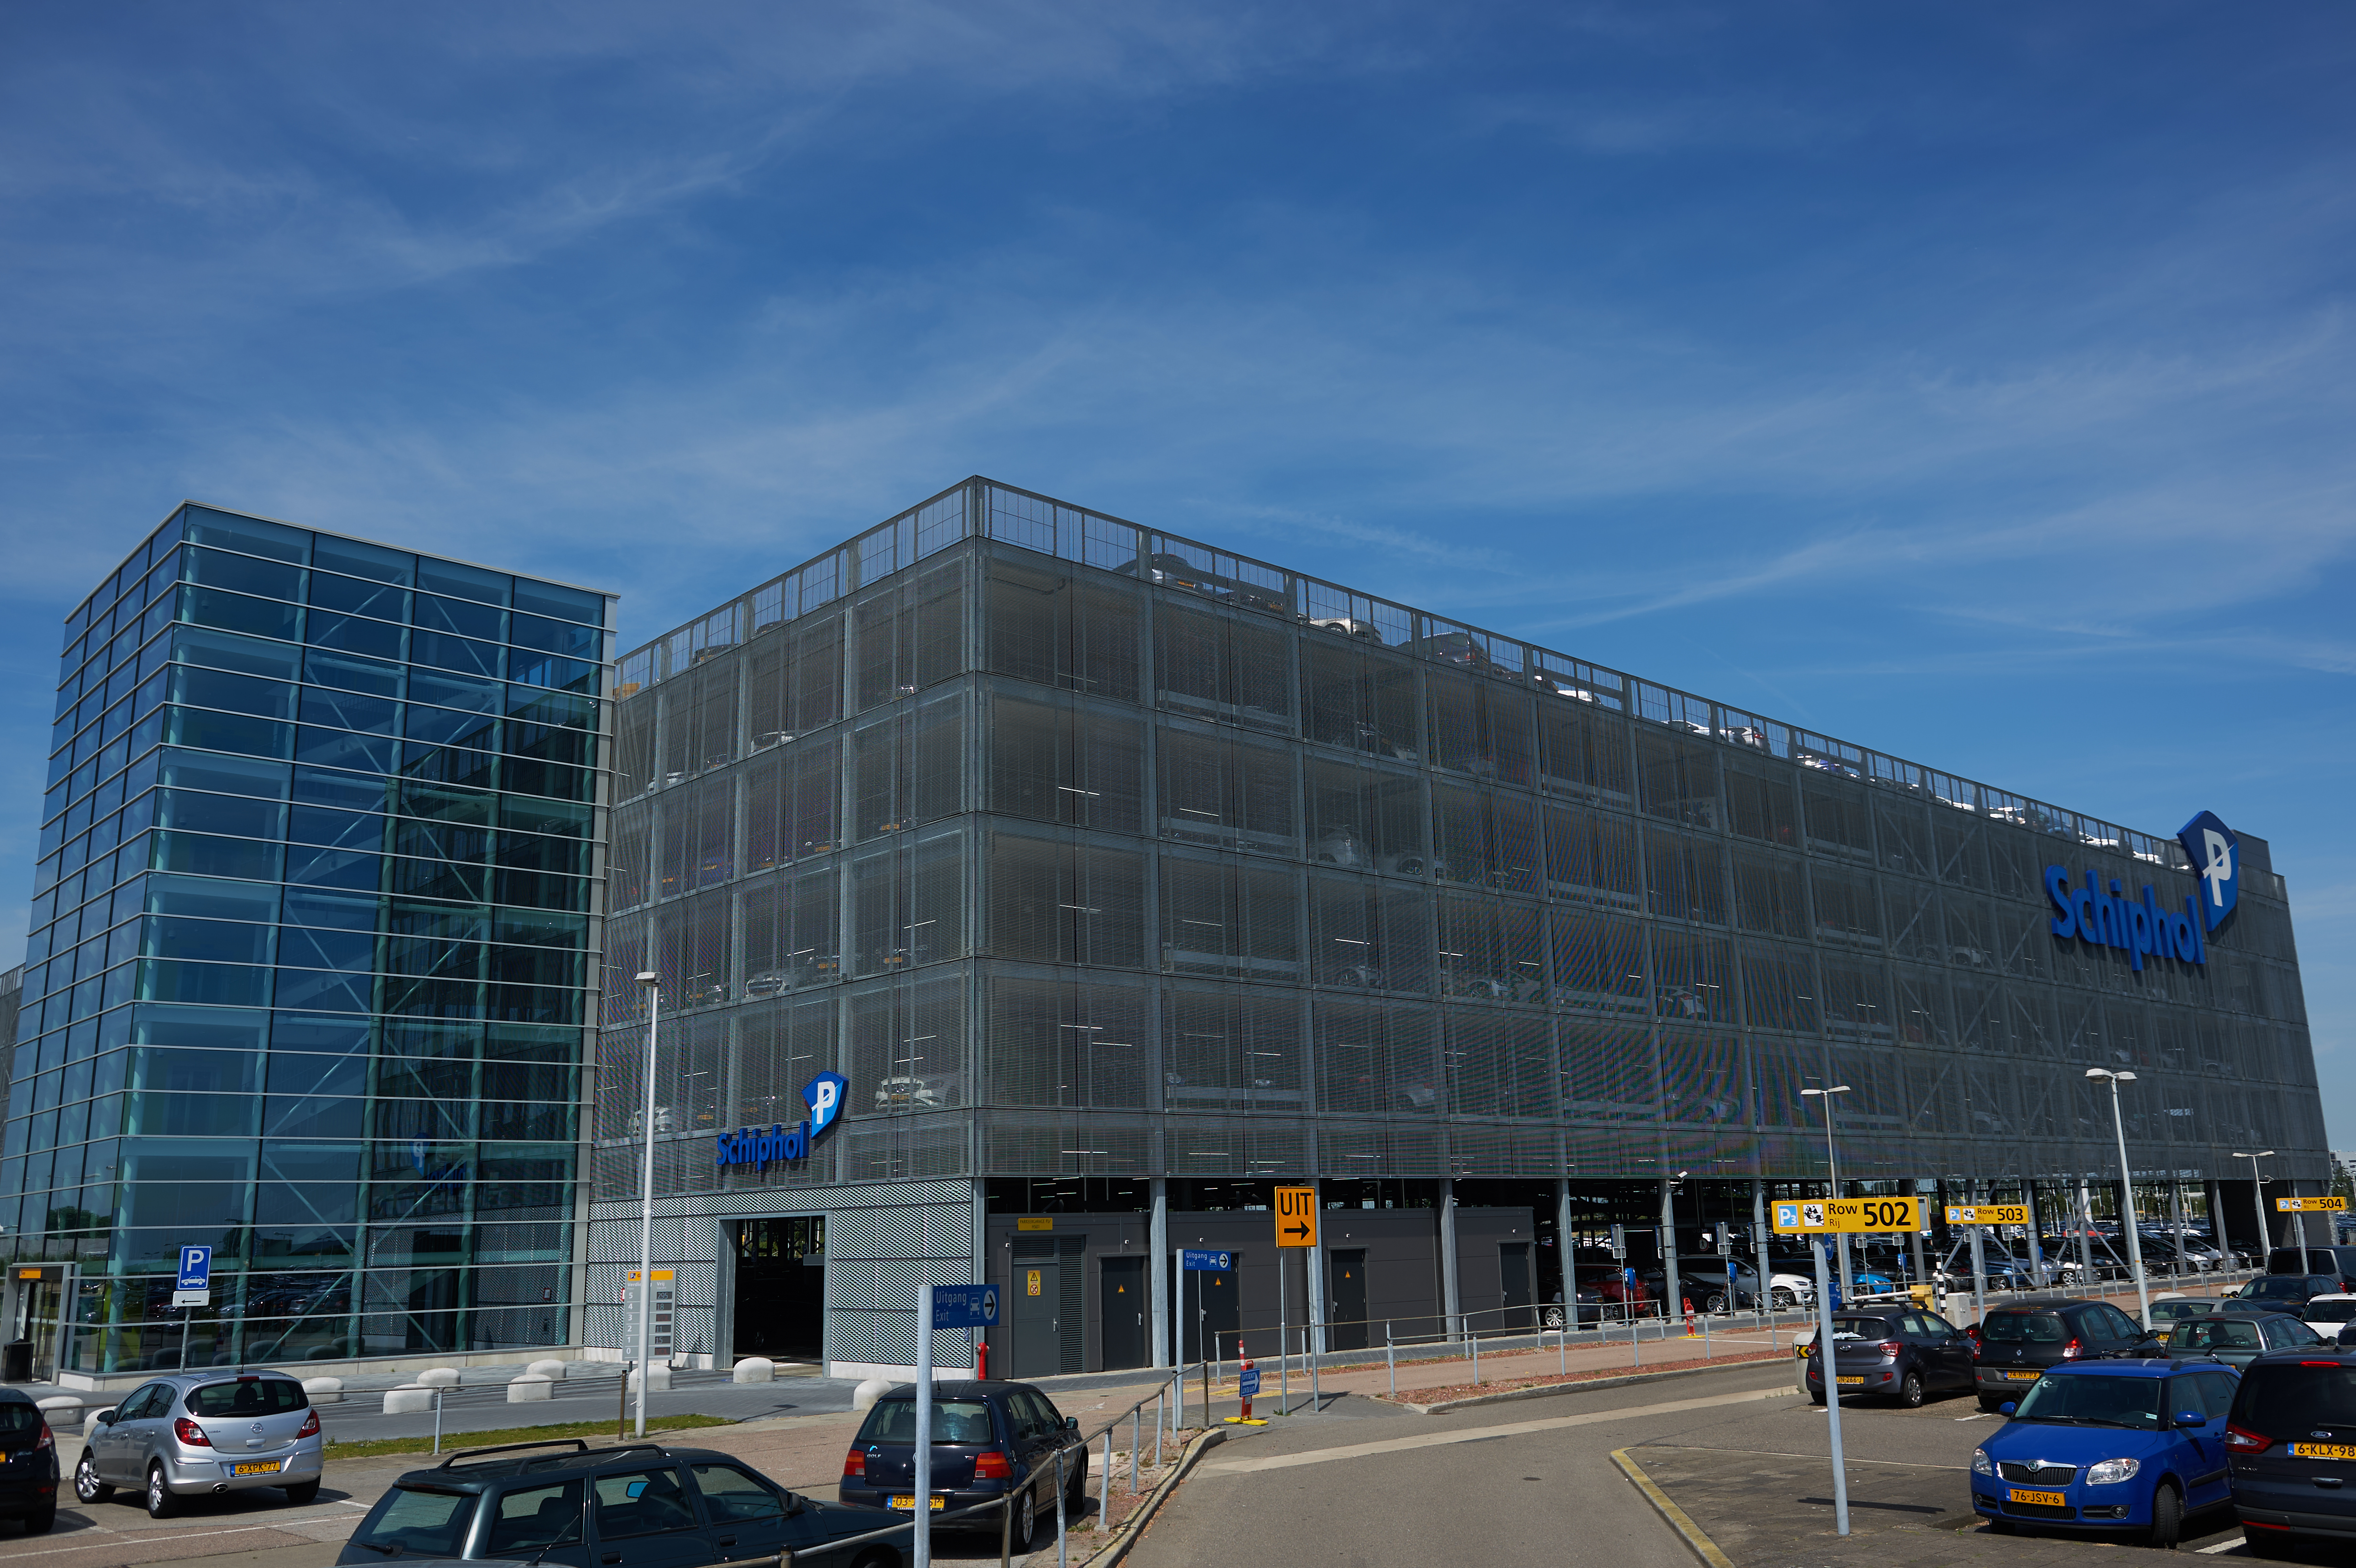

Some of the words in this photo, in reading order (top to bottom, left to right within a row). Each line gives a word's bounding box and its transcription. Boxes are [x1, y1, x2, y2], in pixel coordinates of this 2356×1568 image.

[2045, 865, 2206, 970] Schiphol
[717, 1121, 809, 1171] Schiphol
[1280, 1193, 1311, 1216] UIT
[2320, 1198, 2342, 1209] 504
[1828, 1203, 1857, 1215] Row
[1864, 1202, 1911, 1226] 502
[1997, 1208, 2023, 1221] 503
[1830, 1219, 1840, 1229] Rij
[187, 1250, 204, 1271] P
[1186, 1252, 1207, 1260] Uitgang
[936, 1291, 967, 1307] Uitgang
[936, 1309, 949, 1321] Exit
[2298, 1444, 2356, 1457] 6-KLX-98
[239, 1462, 277, 1473] 6-XPK-77
[2014, 1491, 2060, 1504] 76-JSV-6
